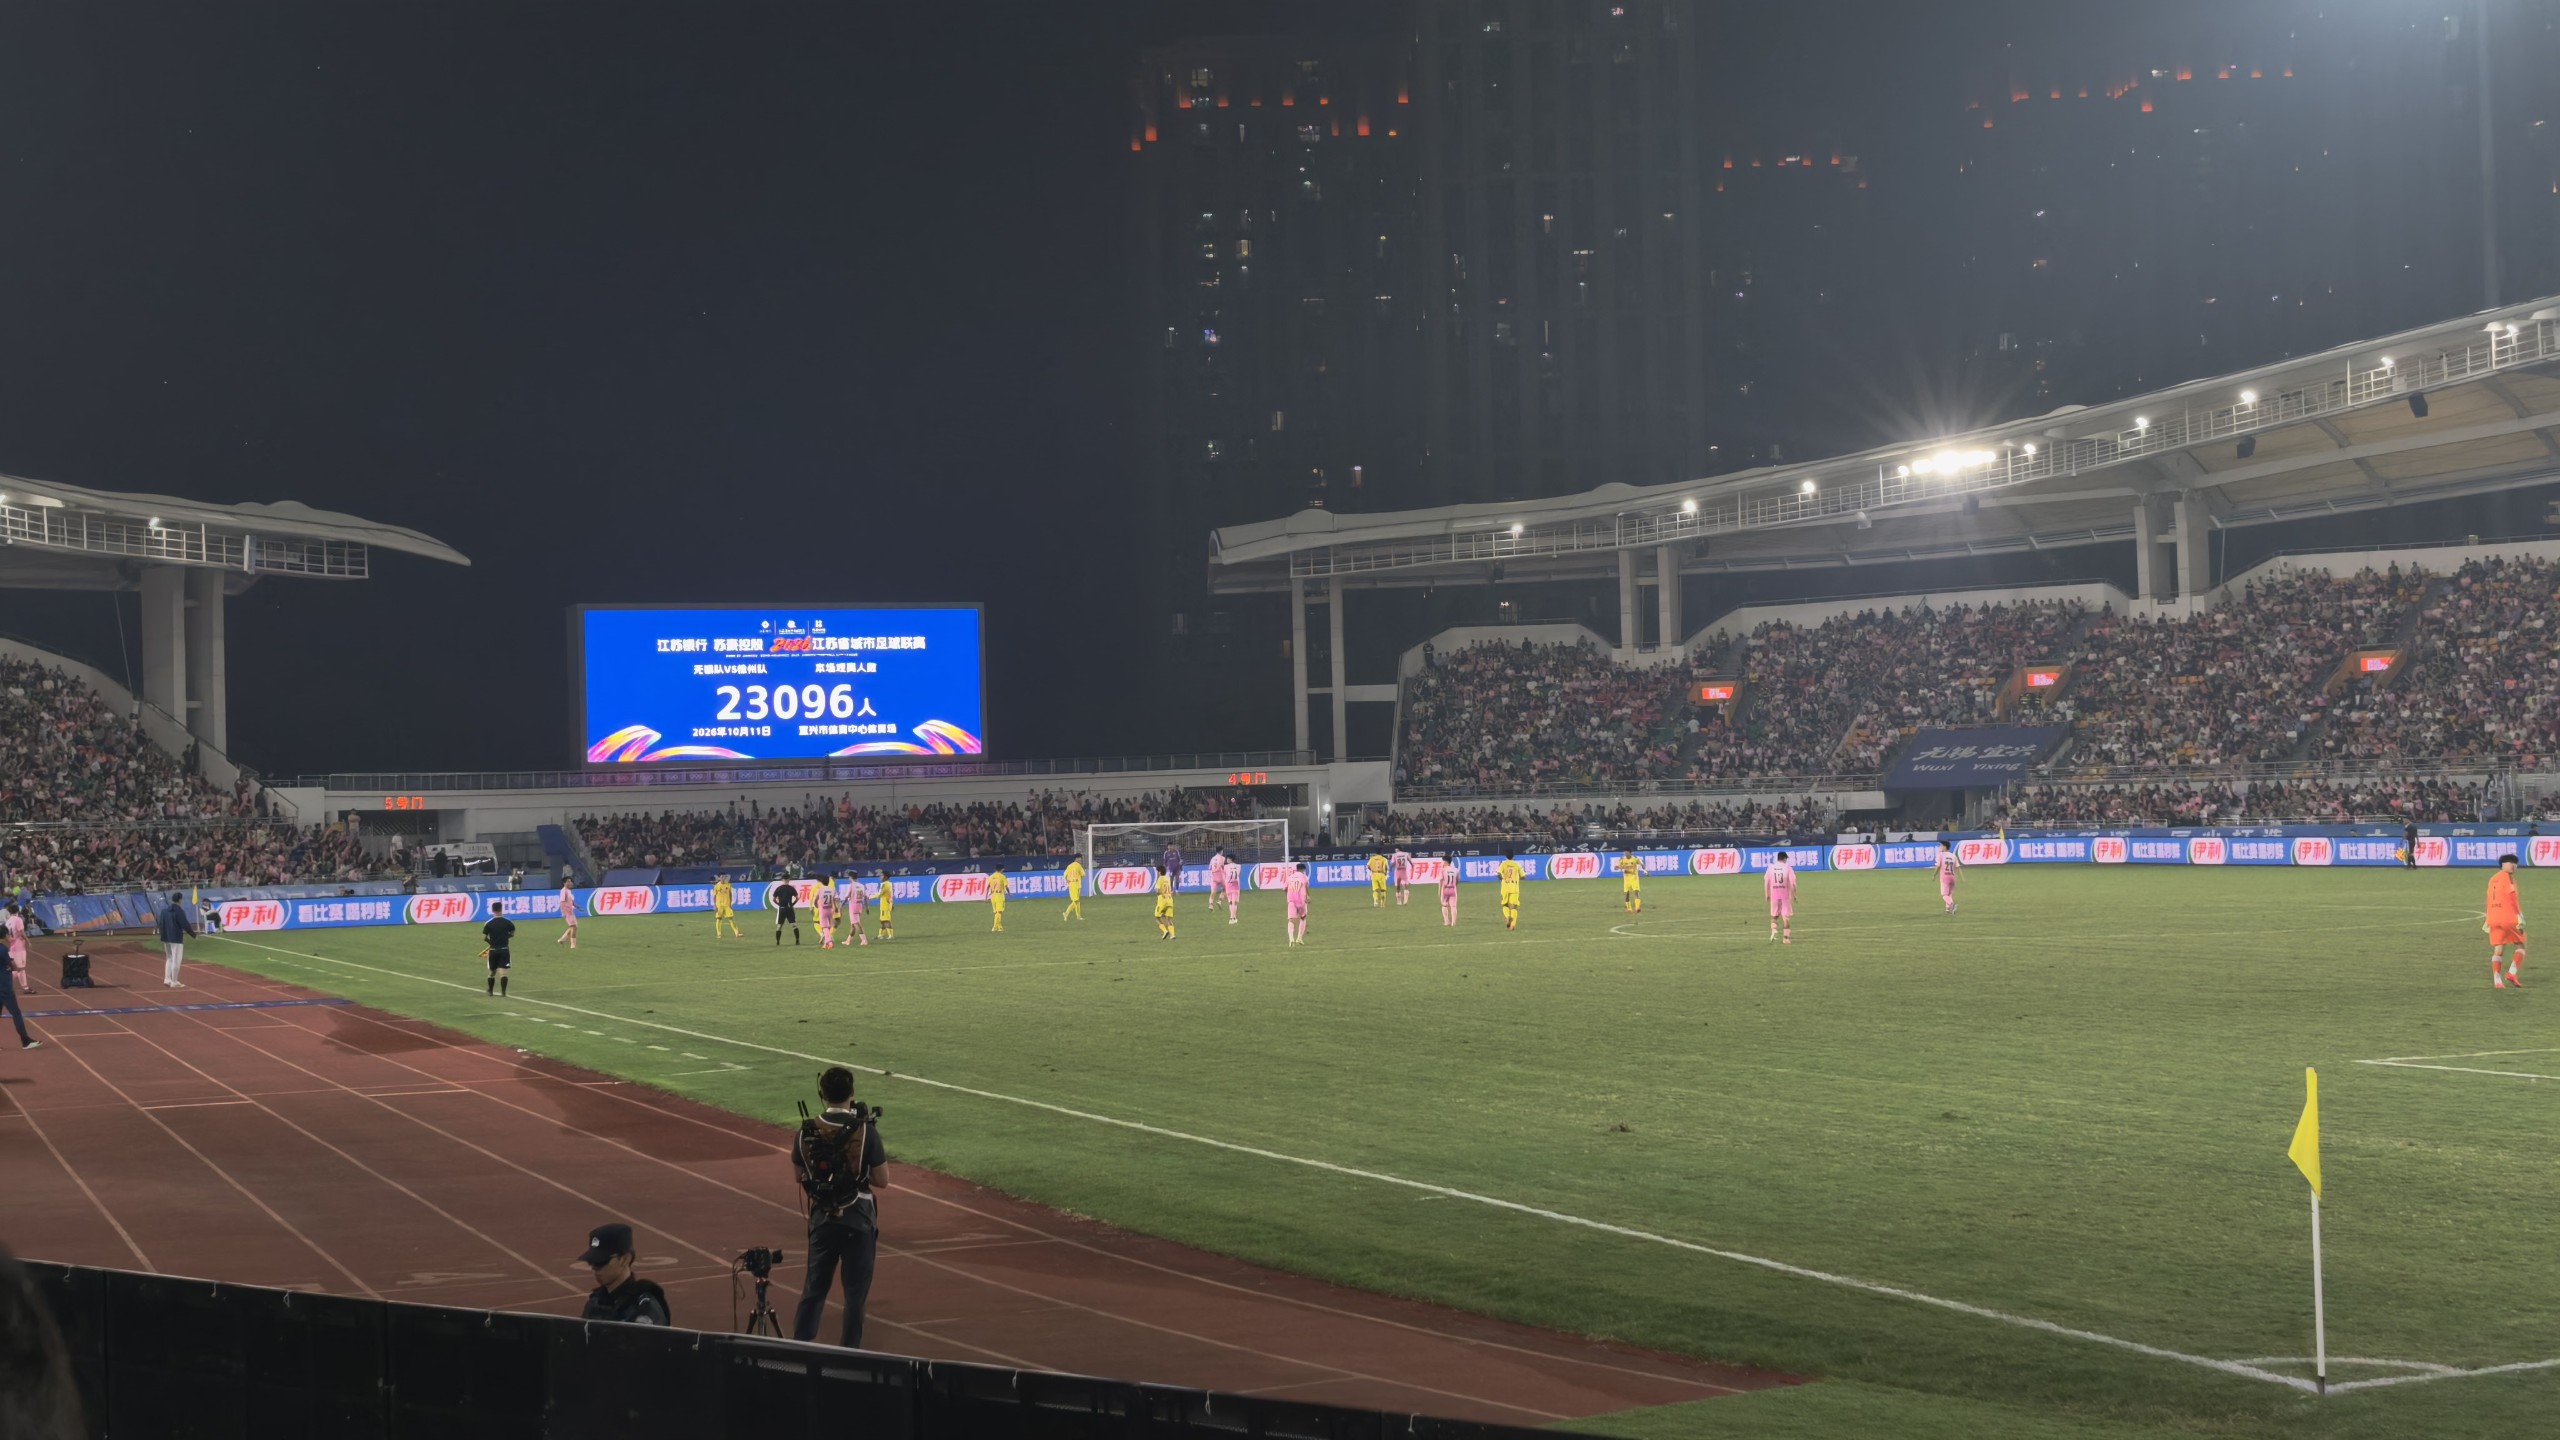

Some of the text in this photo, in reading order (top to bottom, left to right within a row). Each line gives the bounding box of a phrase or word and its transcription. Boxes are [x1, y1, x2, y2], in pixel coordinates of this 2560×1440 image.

[657, 639, 707, 651] 江苏银行
[692, 725, 771, 736] 2026年10月11日
[1972, 763, 2021, 771] Yixing
[1837, 848, 1871, 864] 伊利
[1962, 843, 2002, 859] 伊利
[2097, 842, 2122, 857] 伊利
[2194, 842, 2221, 858] 伊利
[2299, 841, 2328, 858] 伊利
[1397, 858, 1406, 867] 92
[1555, 857, 1594, 874] 伊利
[1697, 853, 1735, 869] 伊利
[1103, 871, 1147, 889] 伊利
[1774, 873, 1784, 883] 13
[942, 877, 986, 896] 伊利
[600, 890, 649, 910] 伊利
[823, 894, 833, 905] 21
[226, 905, 278, 926] 伊利
[416, 898, 468, 918] 伊利
